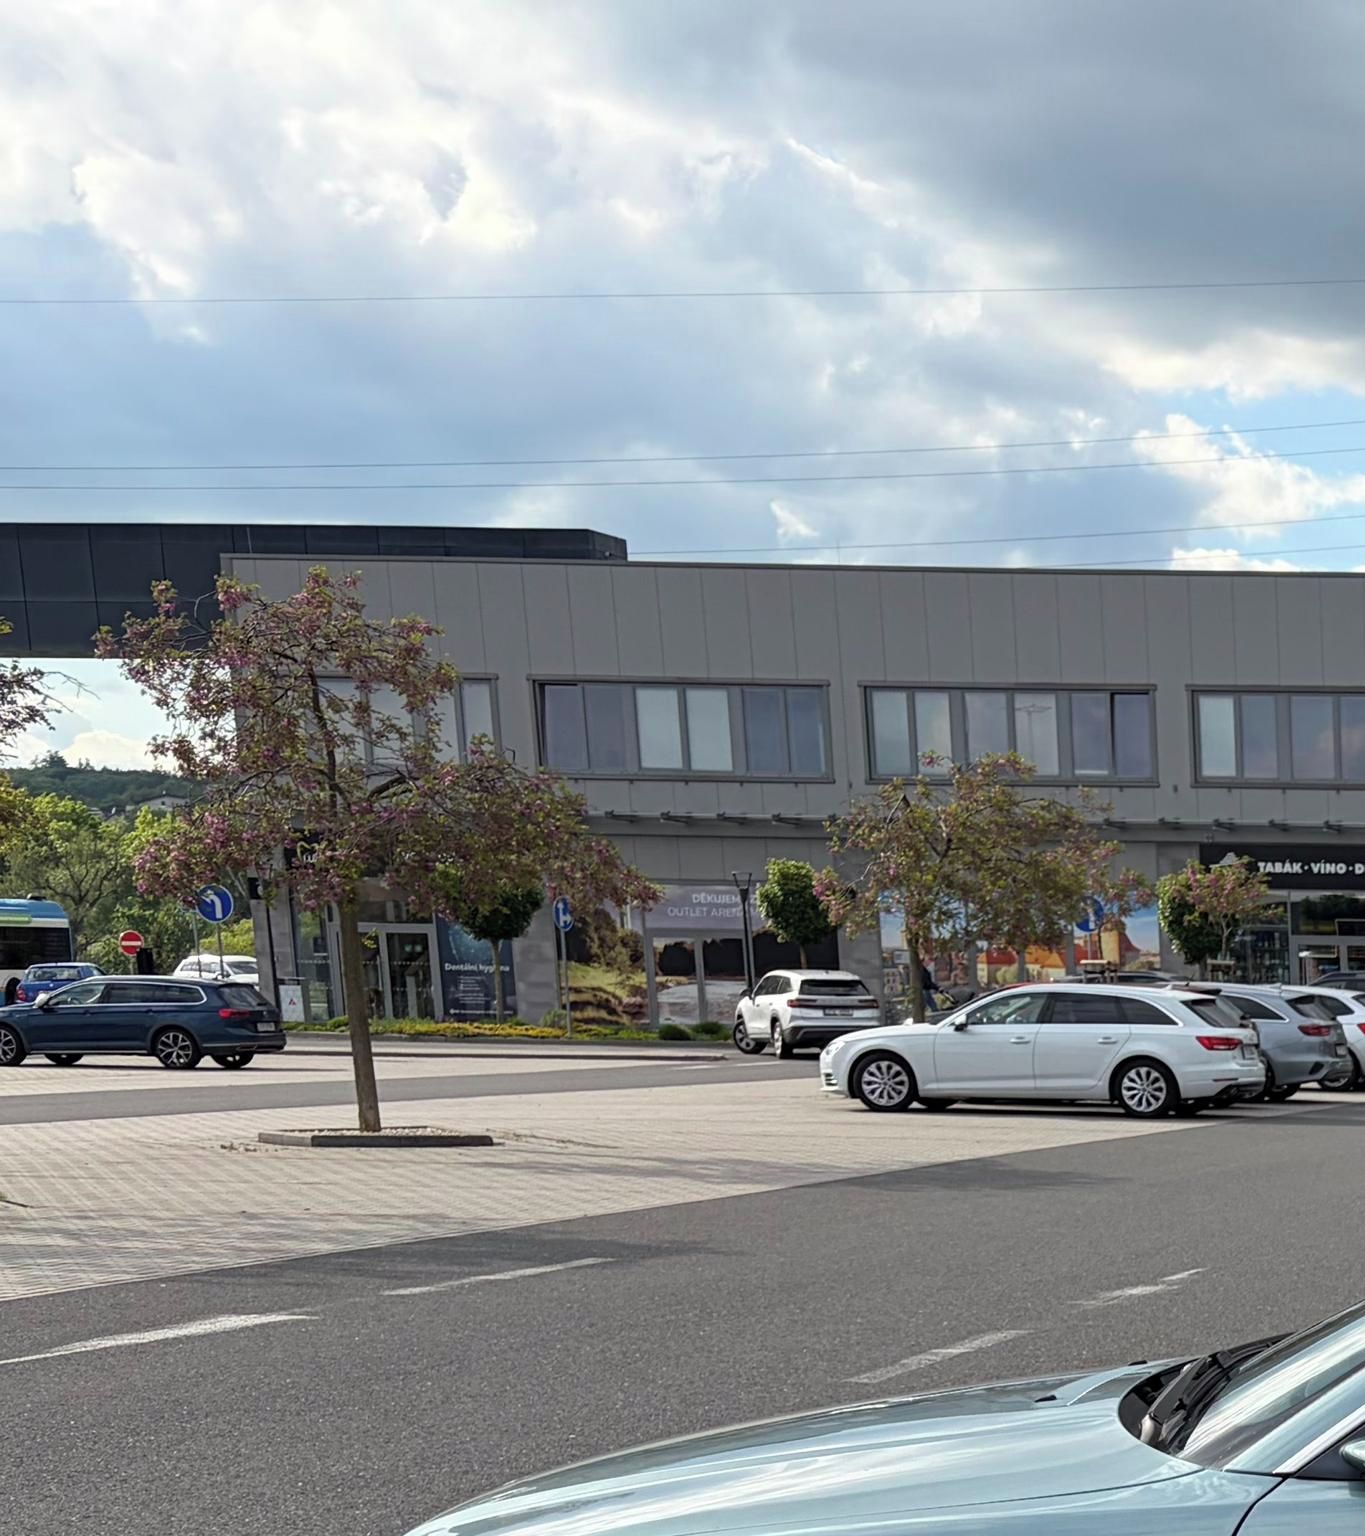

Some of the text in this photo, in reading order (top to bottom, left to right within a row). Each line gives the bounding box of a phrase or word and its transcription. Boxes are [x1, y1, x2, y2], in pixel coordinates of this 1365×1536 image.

[1257, 859, 1302, 873] TABÁK
[1310, 859, 1347, 874] VÍNO
[667, 906, 707, 917] OUTLET
[445, 963, 477, 972] Dentální
